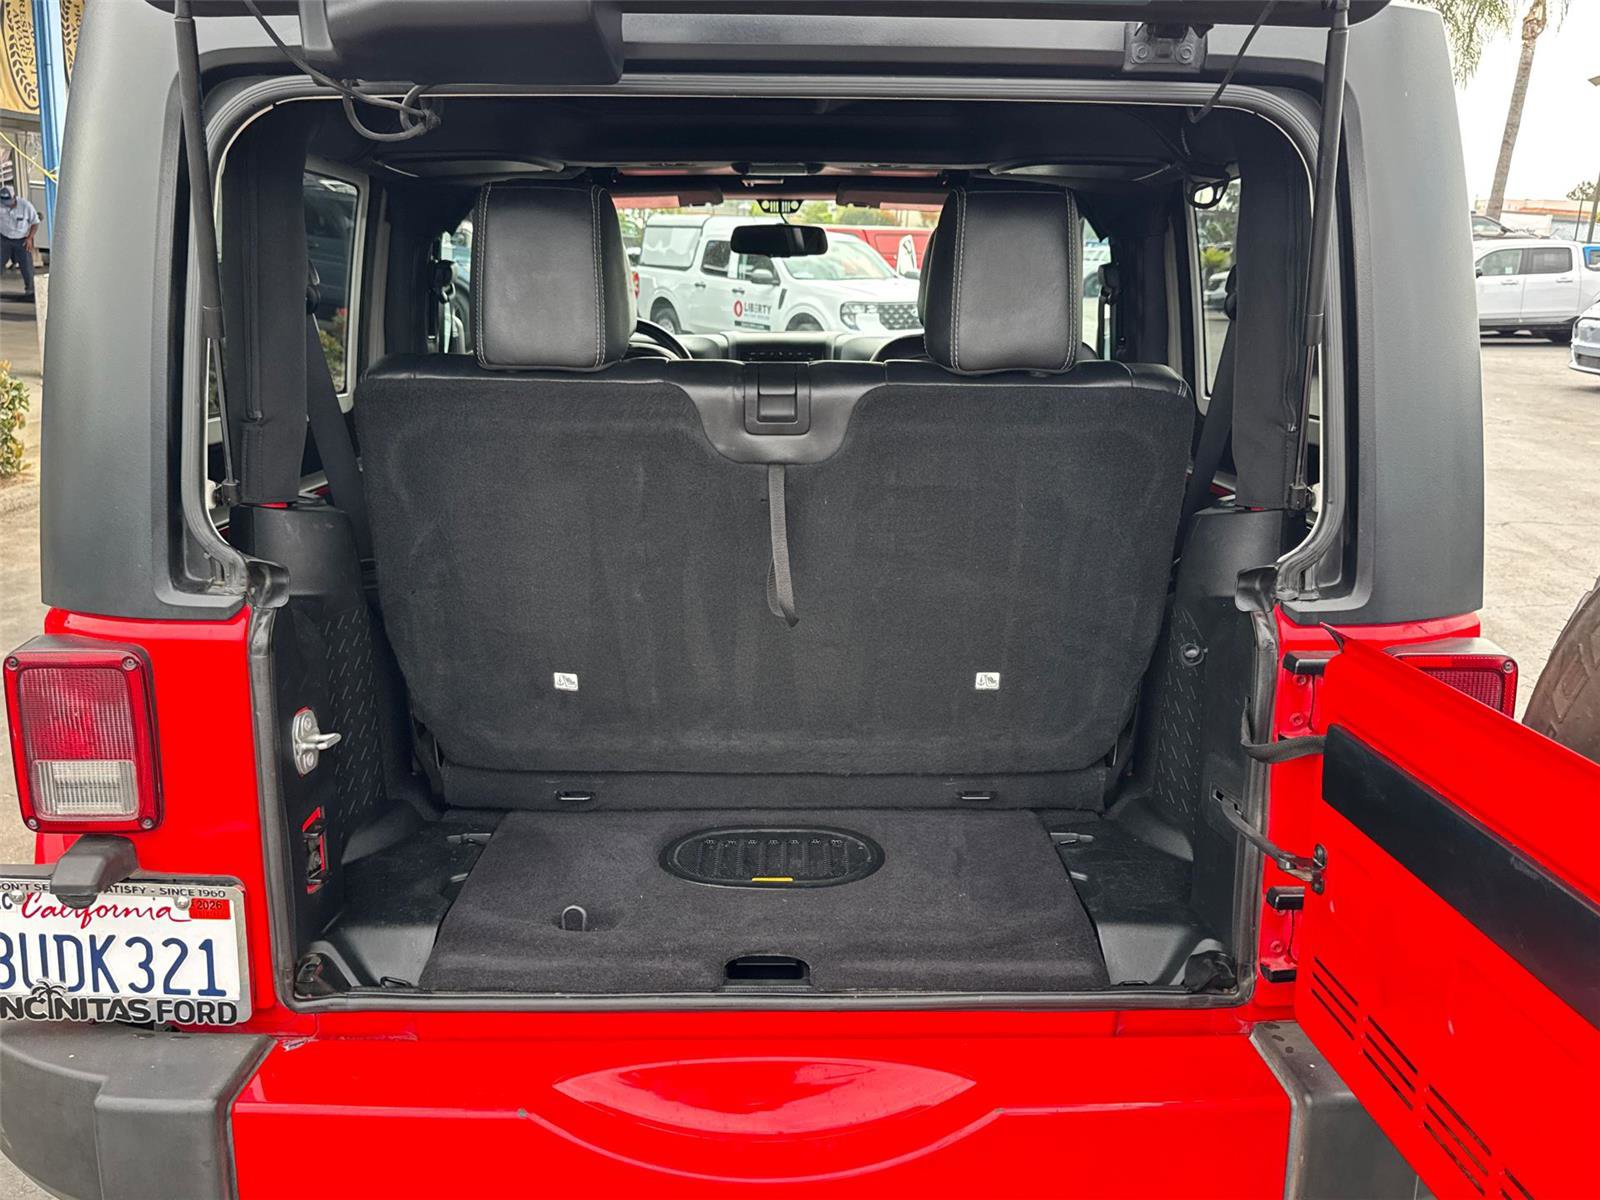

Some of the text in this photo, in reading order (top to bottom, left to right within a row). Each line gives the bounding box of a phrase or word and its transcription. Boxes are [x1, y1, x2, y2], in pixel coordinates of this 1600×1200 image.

[744, 302, 772, 314] LIBERTY
[0, 883, 31, 891] ON'T
[104, 885, 146, 894] ATISFY
[160, 887, 195, 897] SINCE
[198, 889, 226, 898] 1960
[197, 900, 223, 910] 2026
[156, 1000, 238, 1025] FORD
